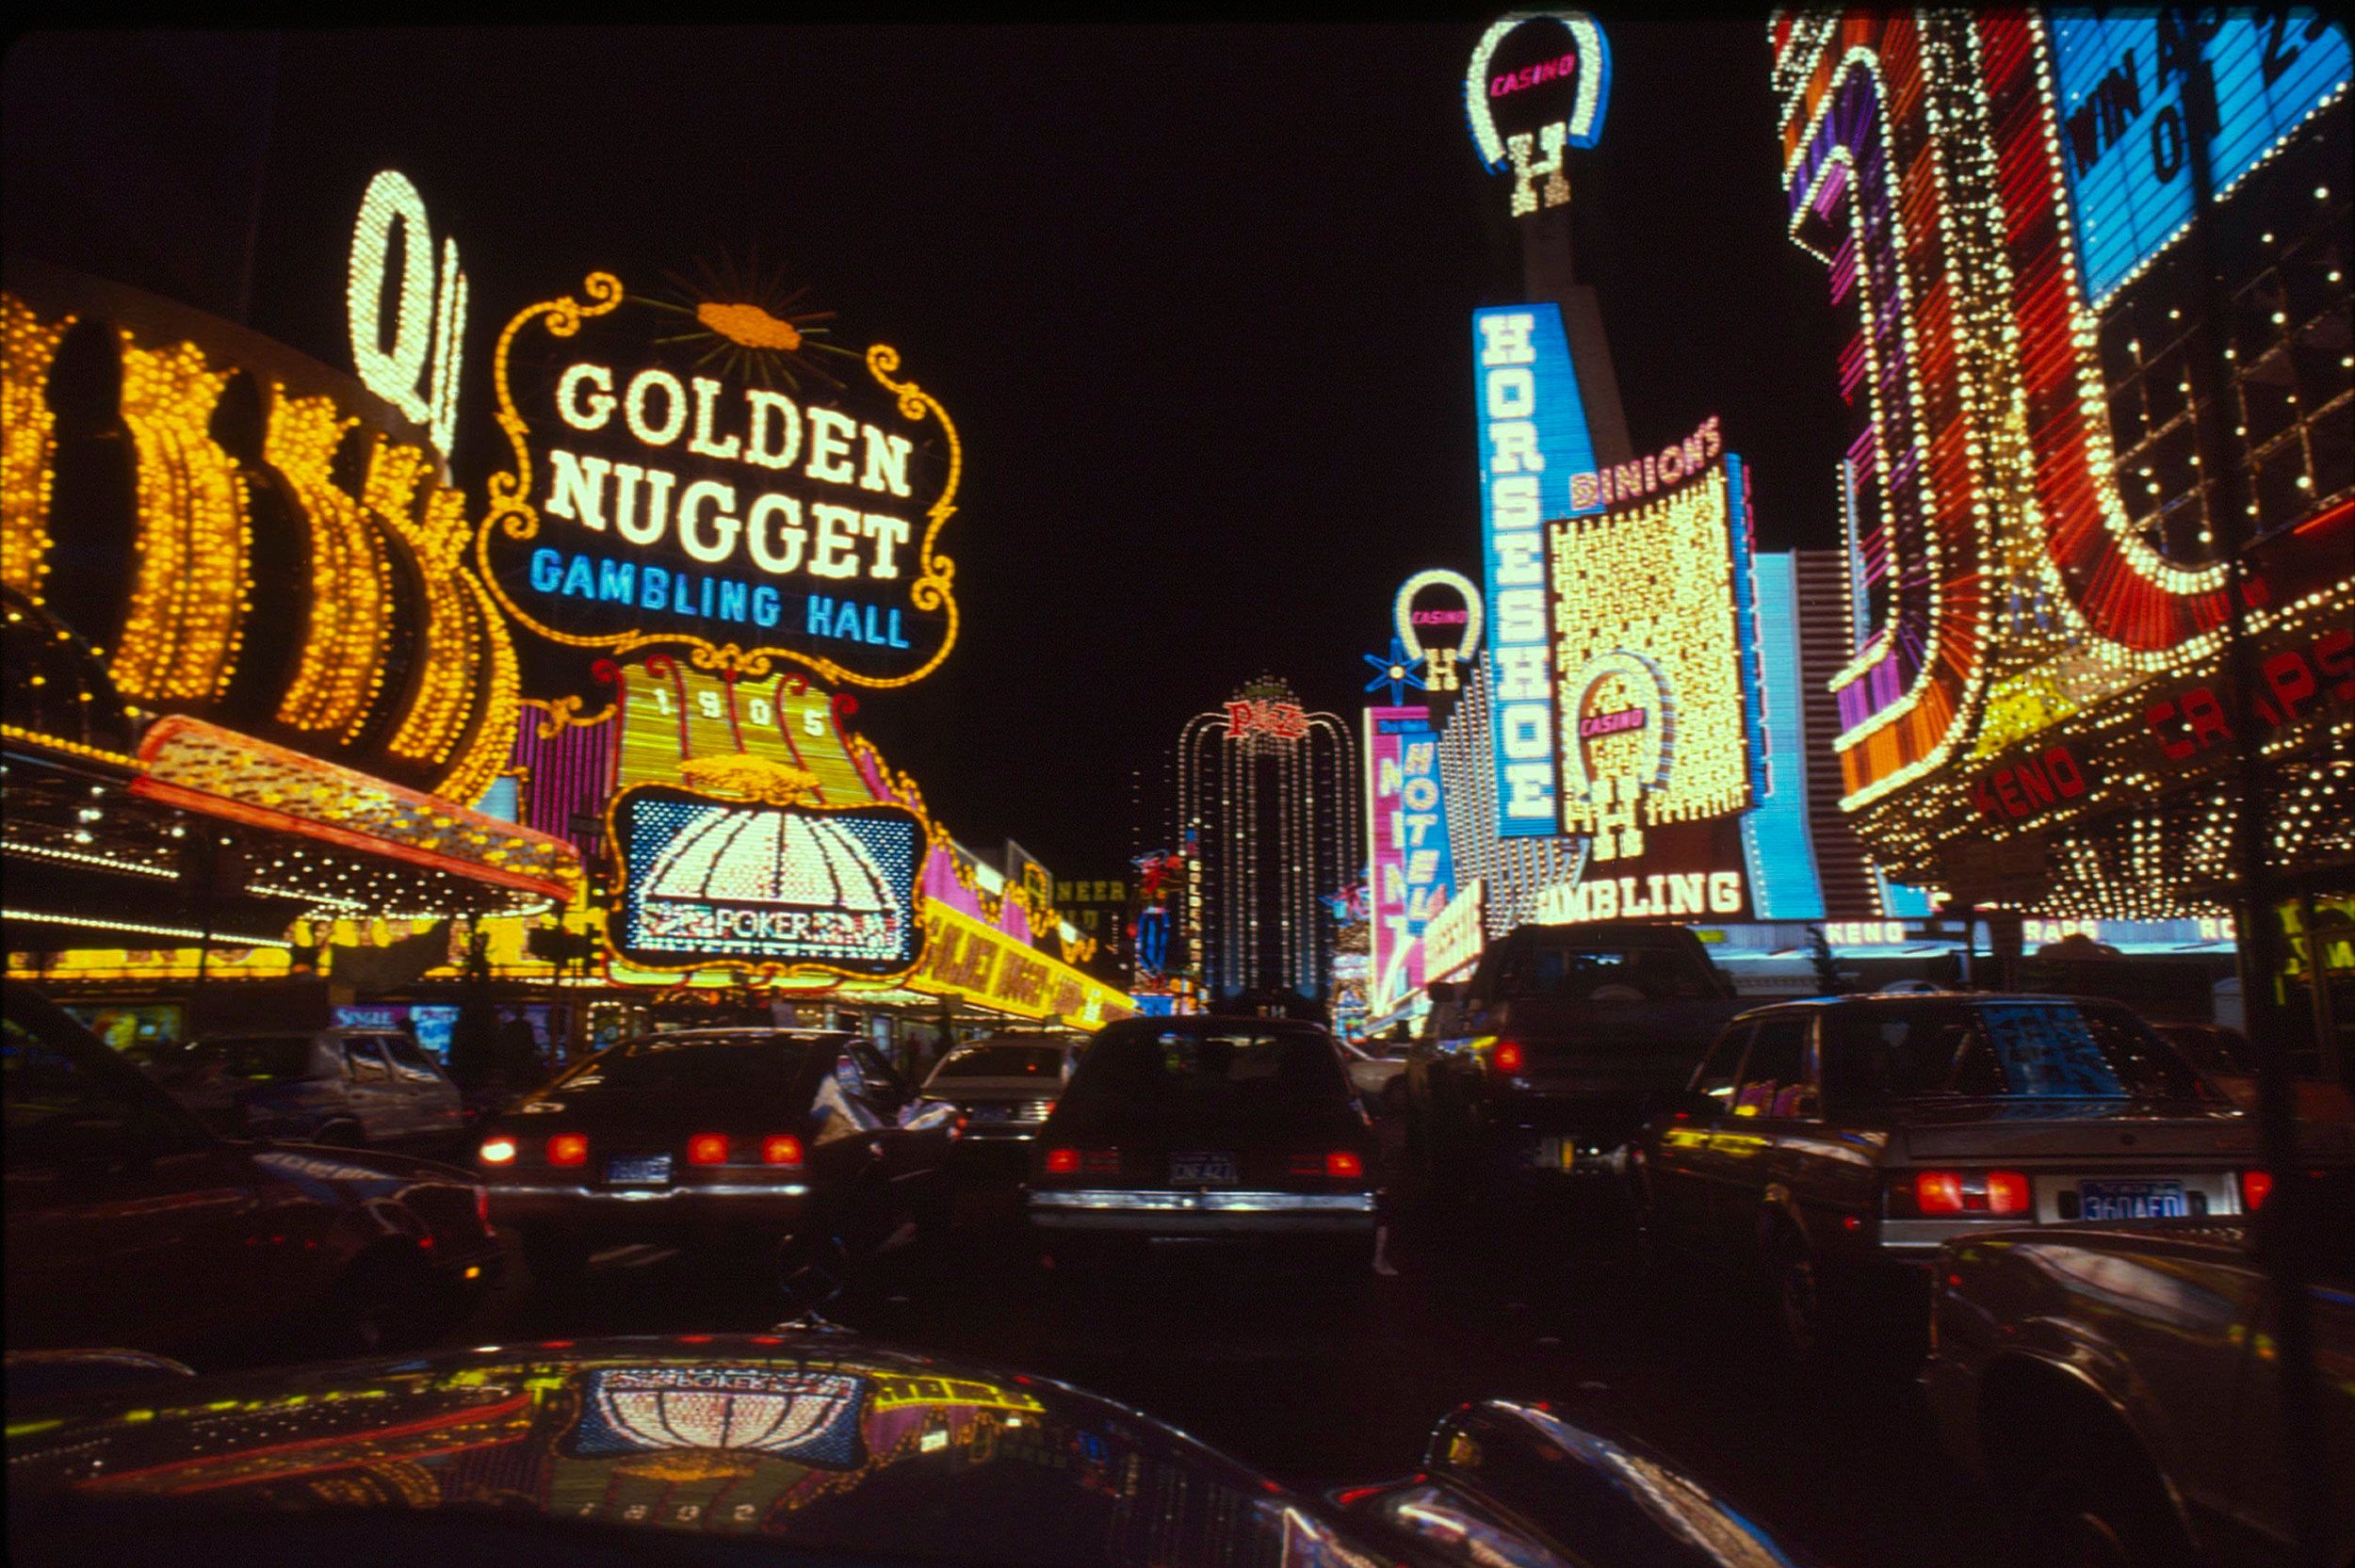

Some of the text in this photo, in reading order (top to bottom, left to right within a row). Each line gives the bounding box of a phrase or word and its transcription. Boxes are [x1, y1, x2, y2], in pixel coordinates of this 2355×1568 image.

[1490, 54, 1576, 97] CASINO
[1507, 121, 1571, 218] H
[556, 363, 913, 497] GOLDEN
[1569, 414, 1720, 511] BINION'S
[544, 449, 910, 579] NUGGET
[528, 547, 910, 650] GAMBLING HALL
[1480, 314, 1555, 818] HORSESHOE
[1412, 609, 1470, 625] CASINO
[654, 687, 826, 737] 1905
[1579, 707, 1646, 738] CASINO
[2145, 628, 2355, 760] CRPS
[1972, 746, 2085, 825] KENO
[1403, 741, 1440, 922] HOTEL
[715, 908, 813, 942] POKER
[1825, 922, 1906, 944] KENO
[2022, 920, 2099, 943] RAPS
